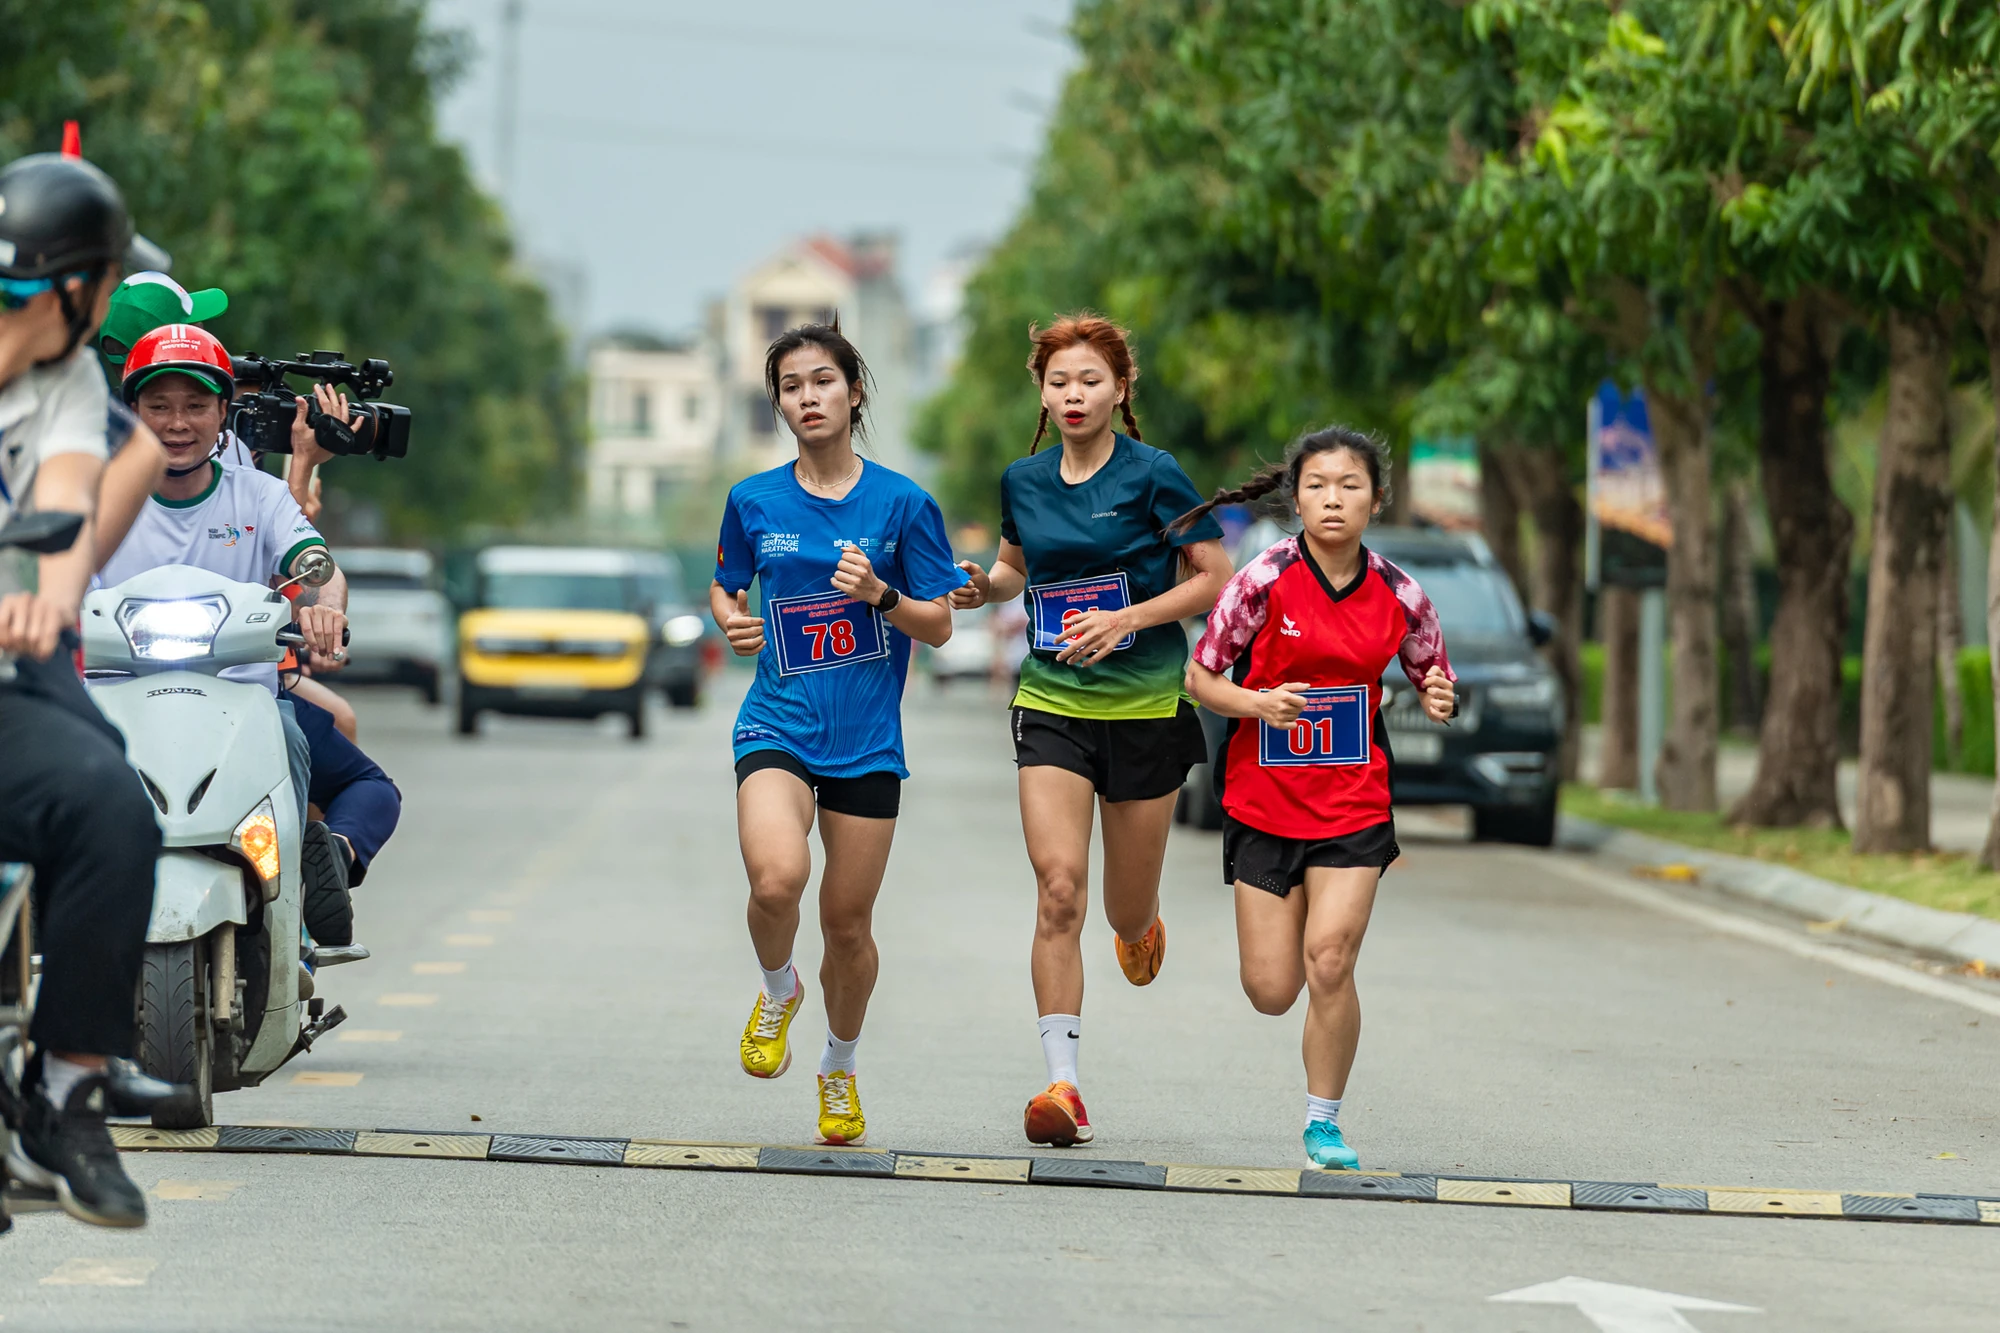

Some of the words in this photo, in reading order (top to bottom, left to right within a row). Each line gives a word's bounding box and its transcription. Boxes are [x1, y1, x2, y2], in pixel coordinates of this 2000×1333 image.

[335, 430, 351, 443] SONY
[761, 539, 799, 547] HERITAGE
[761, 545, 799, 554] MARATHON
[802, 619, 856, 660] 78
[1288, 717, 1333, 756] 01
